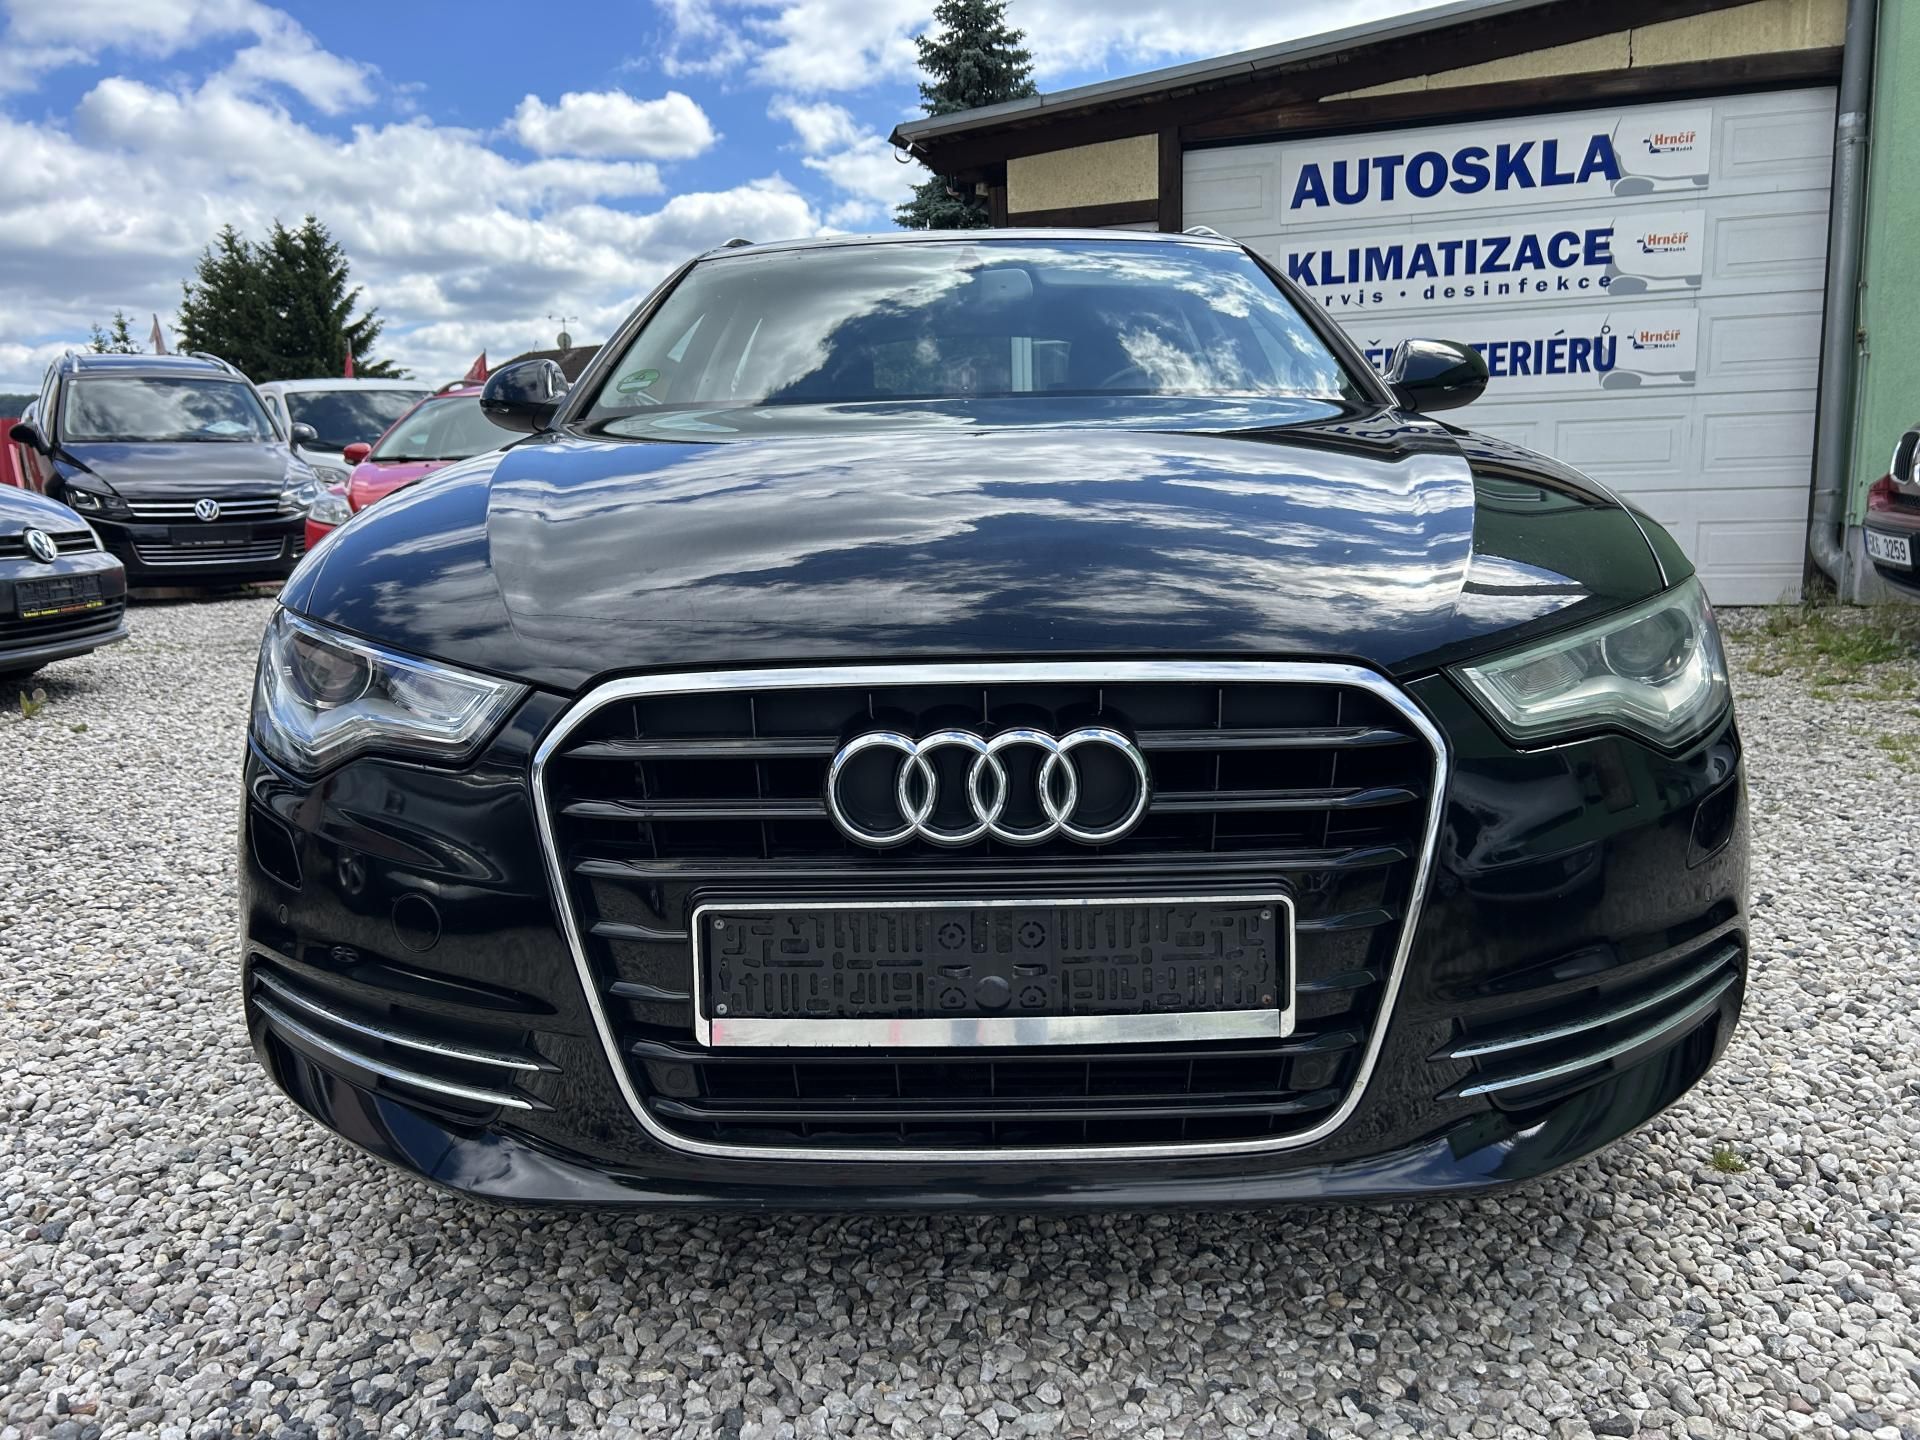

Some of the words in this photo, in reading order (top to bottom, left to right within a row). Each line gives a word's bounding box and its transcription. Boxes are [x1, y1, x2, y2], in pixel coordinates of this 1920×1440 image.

[1290, 133, 1622, 210] AUTOSKLA
[1288, 227, 1615, 287] KLIMATIZACE
[1313, 289, 1384, 307] rvis
[1423, 274, 1611, 299] desinfekce
[1883, 537, 1907, 561] 3259
